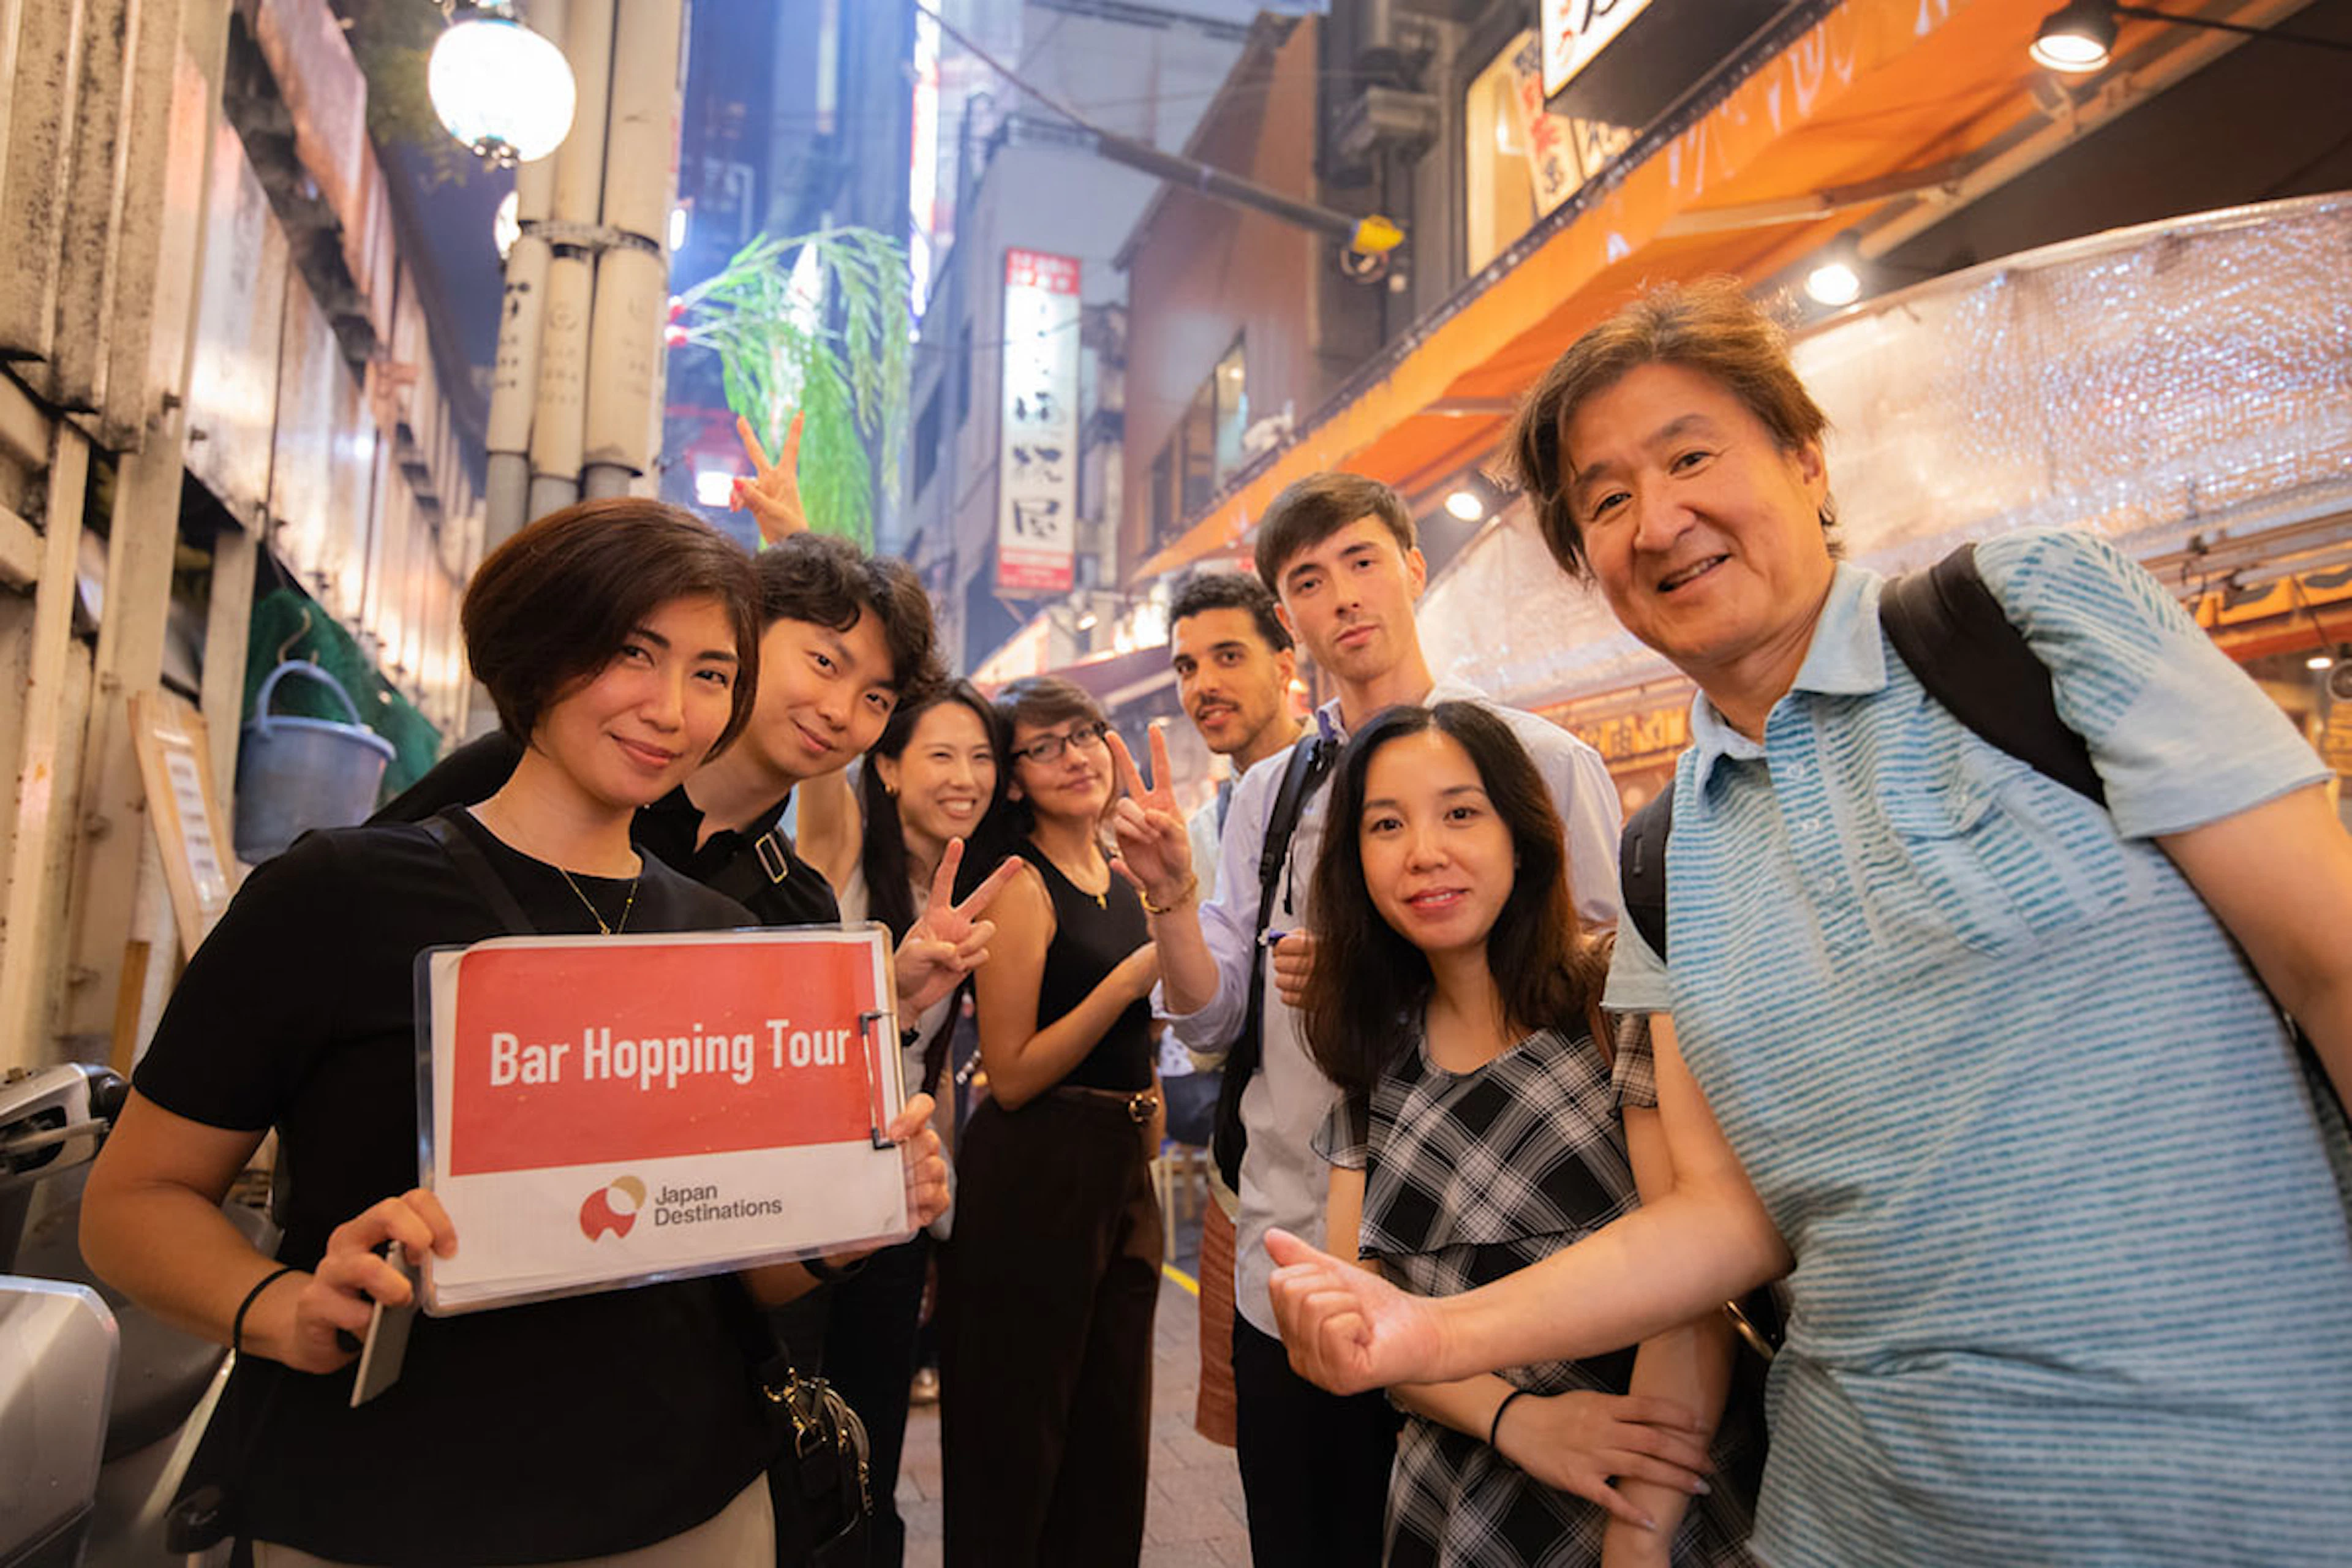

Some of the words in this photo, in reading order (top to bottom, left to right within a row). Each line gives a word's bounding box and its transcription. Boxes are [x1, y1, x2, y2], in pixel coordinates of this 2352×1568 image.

[491, 1031, 570, 1087] Bar
[583, 1022, 754, 1091] Hopping
[766, 1019, 851, 1069] Tour
[655, 1184, 718, 1206] Japan
[654, 1197, 783, 1226] Destinations
